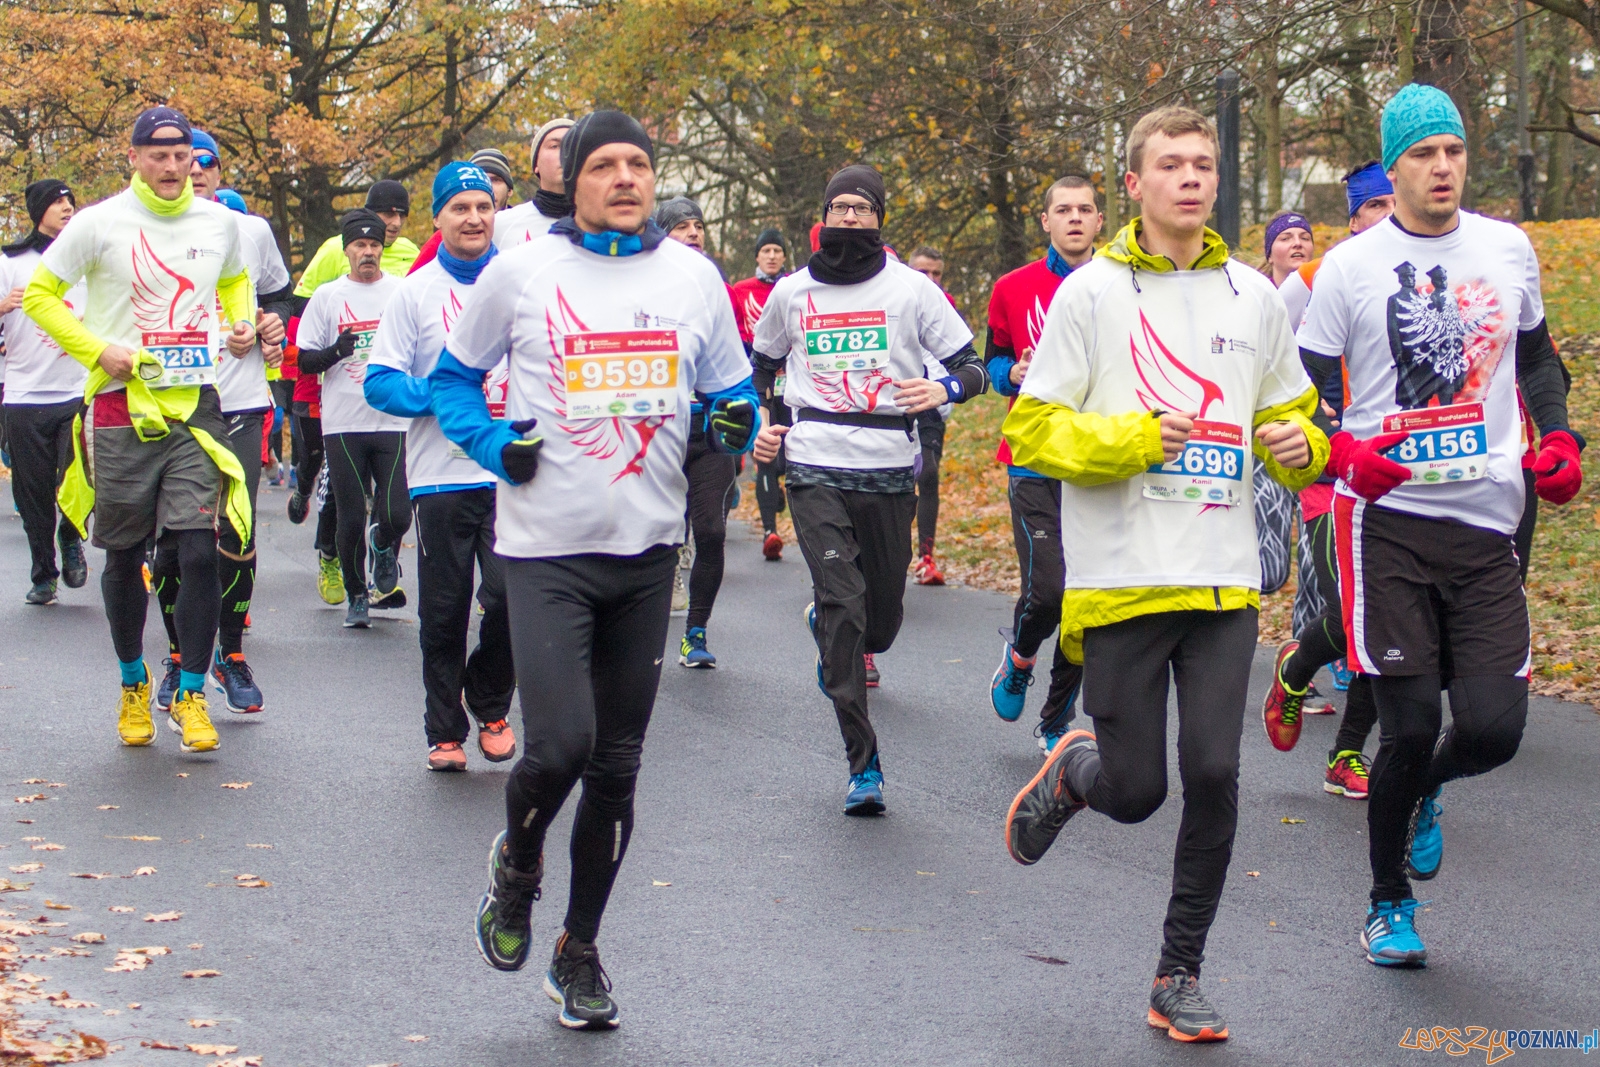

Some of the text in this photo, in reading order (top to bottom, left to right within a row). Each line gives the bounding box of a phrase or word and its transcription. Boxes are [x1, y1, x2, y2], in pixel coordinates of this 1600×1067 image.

[627, 339, 673, 347] RunPoland.org
[817, 330, 879, 352] 6782
[153, 349, 205, 367] 8281
[581, 358, 670, 389] 9598
[1438, 412, 1479, 422] RunPoland.org
[1207, 429, 1240, 441] RunPoland.org
[1399, 429, 1478, 461] 8156
[1161, 447, 1238, 477] 2698
